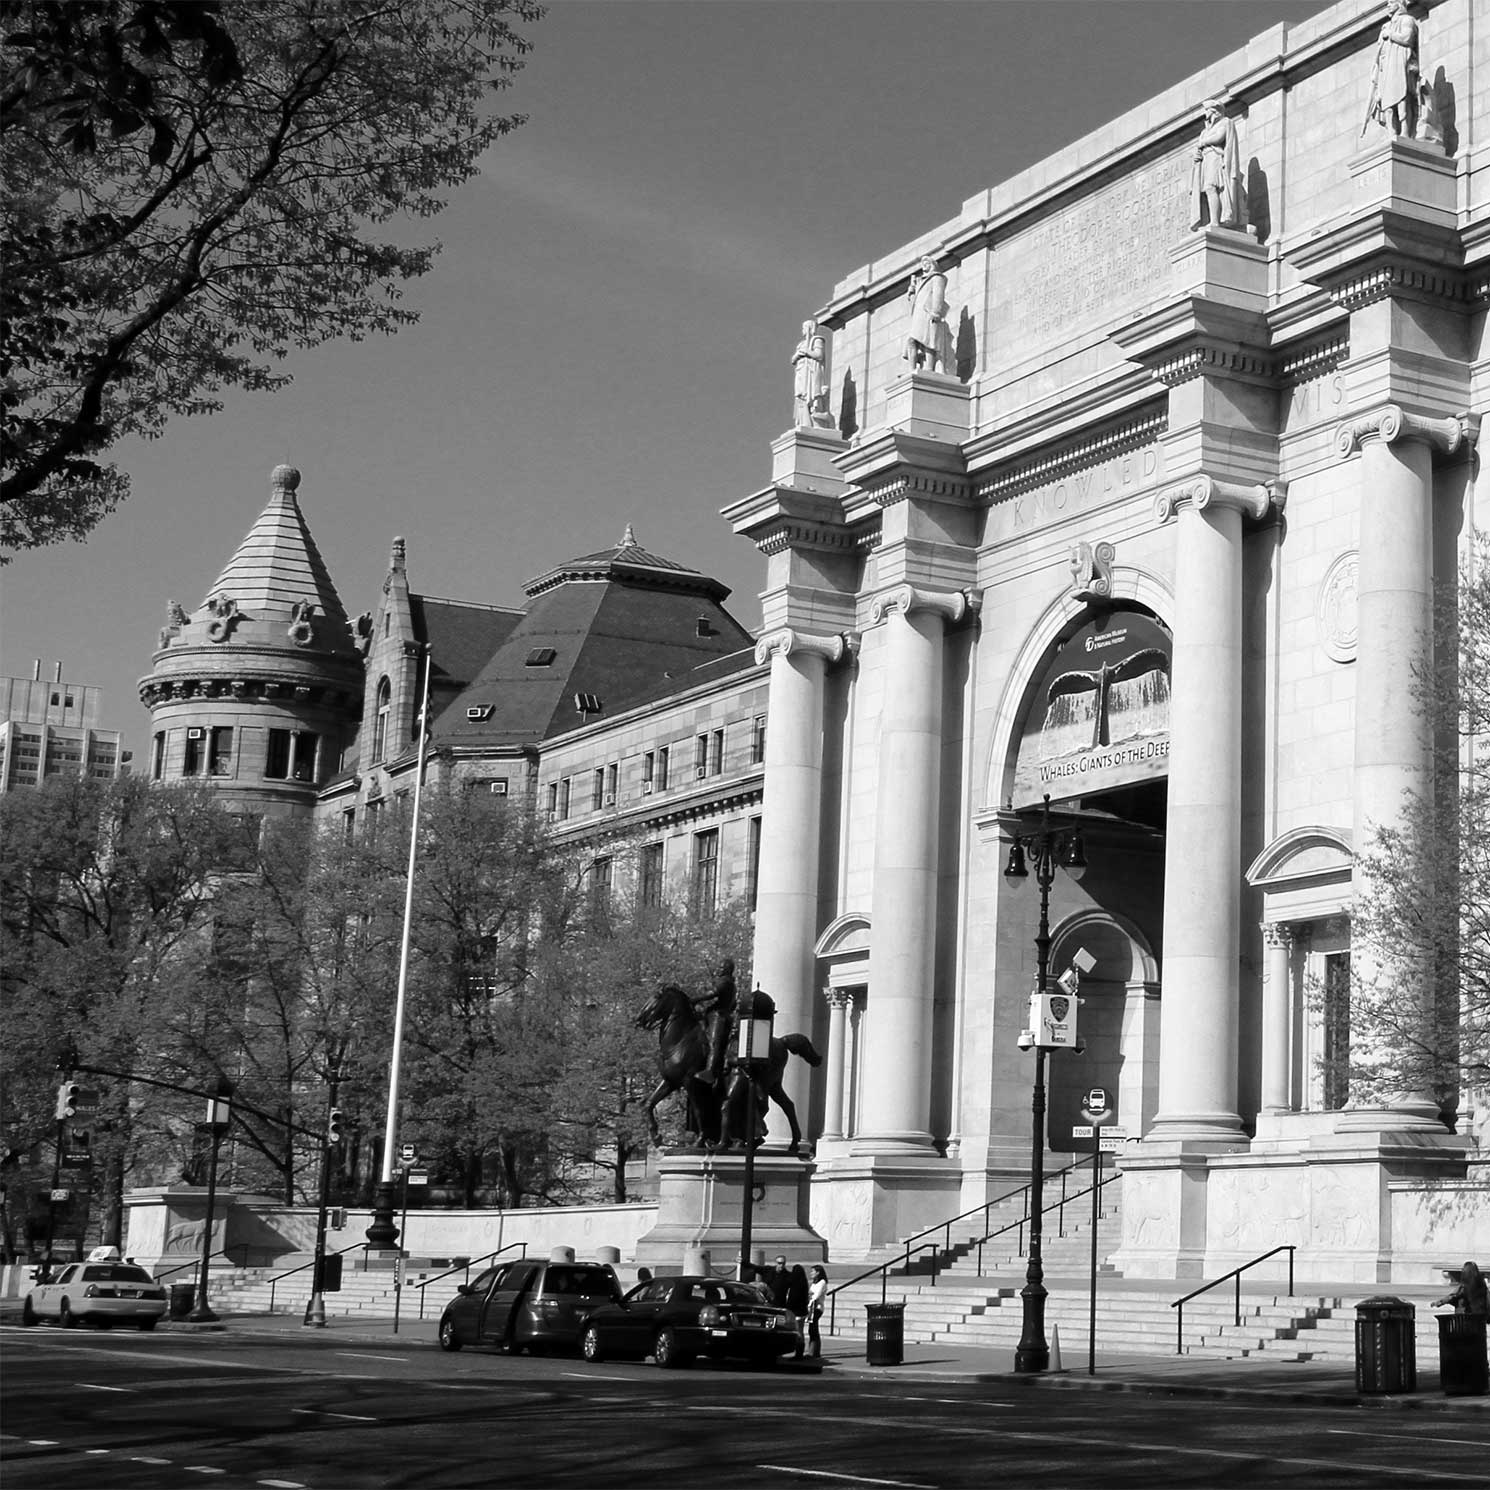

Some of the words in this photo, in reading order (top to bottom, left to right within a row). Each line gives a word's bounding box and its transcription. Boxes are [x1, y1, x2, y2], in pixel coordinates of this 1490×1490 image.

[1050, 214, 1111, 258] THEODORE
[1115, 178, 1182, 223] ROOSEVELT
[1094, 632, 1112, 642] AMERICAN
[1111, 628, 1127, 637] MUSEUM
[1040, 762, 1079, 781] WHALES:
[1080, 756, 1112, 773] GIANTS
[1114, 752, 1126, 765] OF
[1128, 747, 1145, 762] THE
[1075, 1128, 1092, 1136] TOUR
